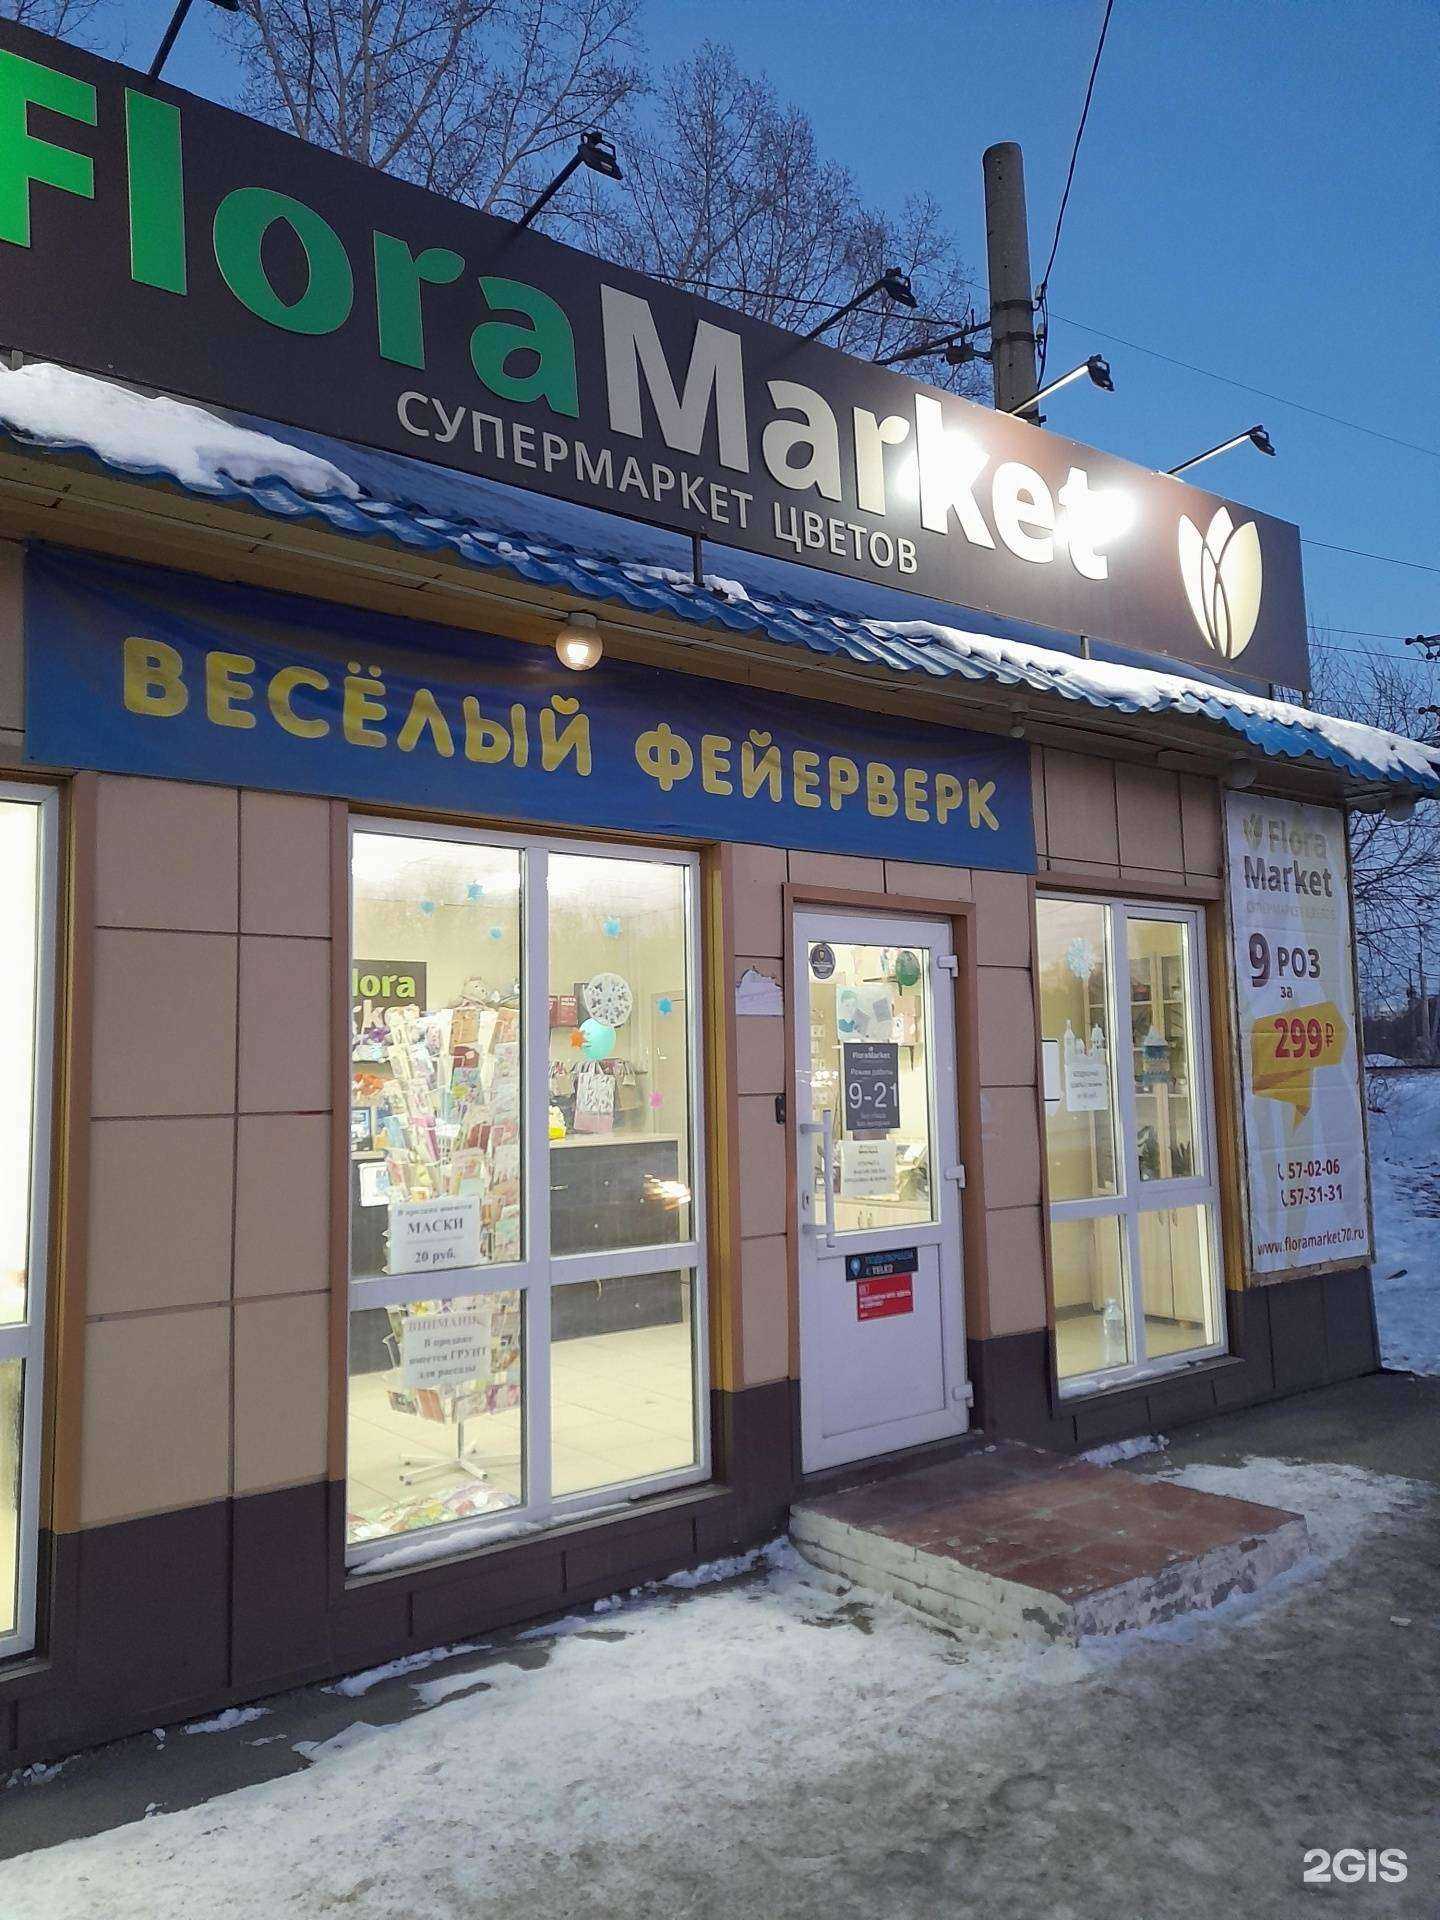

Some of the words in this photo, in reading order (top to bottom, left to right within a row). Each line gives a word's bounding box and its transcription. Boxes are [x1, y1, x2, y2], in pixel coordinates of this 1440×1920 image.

[397, 391, 753, 529] СУПЕРМАРКЕТ
[774, 501, 918, 574] ЦВЕТОВ
[123, 636, 592, 777] ВЕСЁЛЫЙ
[635, 722, 1000, 831] ФЕЙЕРВЕРК
[1268, 818, 1328, 860] Flora
[1244, 855, 1333, 898] Market
[1249, 932, 1271, 988] 9
[1278, 946, 1321, 979] РОЗ
[849, 1081, 898, 1109] 9-21
[1288, 1158, 1341, 1180] 57-02-06
[1289, 1183, 1343, 1207] 57-31-31
[407, 1217, 464, 1234] МАСКИ
[1257, 1227, 1364, 1256] www.floramarket70.ru
